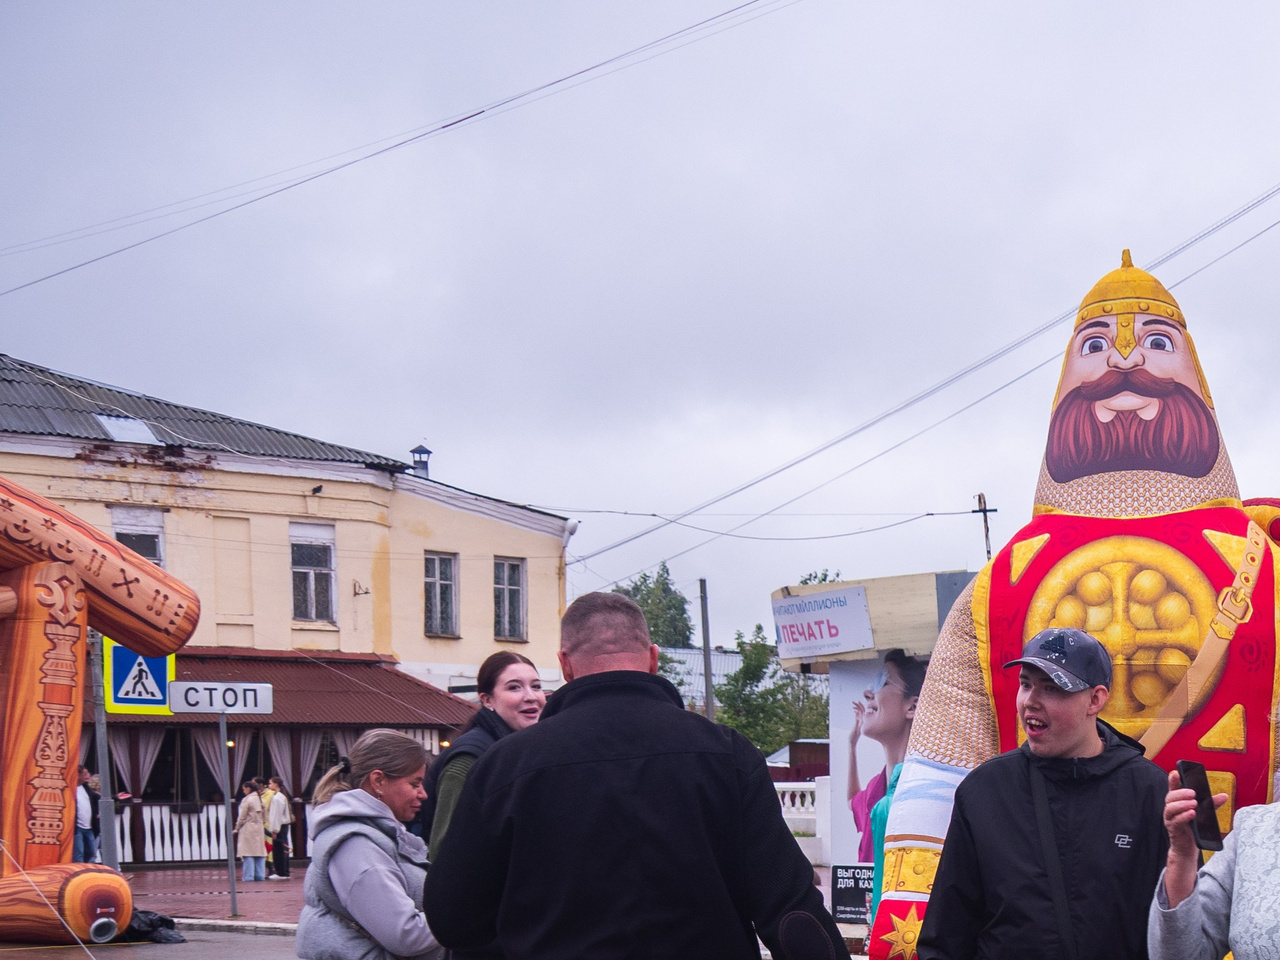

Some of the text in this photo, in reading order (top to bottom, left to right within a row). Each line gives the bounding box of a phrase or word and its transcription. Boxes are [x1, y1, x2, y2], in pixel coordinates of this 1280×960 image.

[781, 619, 840, 644] ПЕЧАТЬ
[184, 687, 258, 708] СТОП
[837, 879, 855, 889] ДЛЯ
